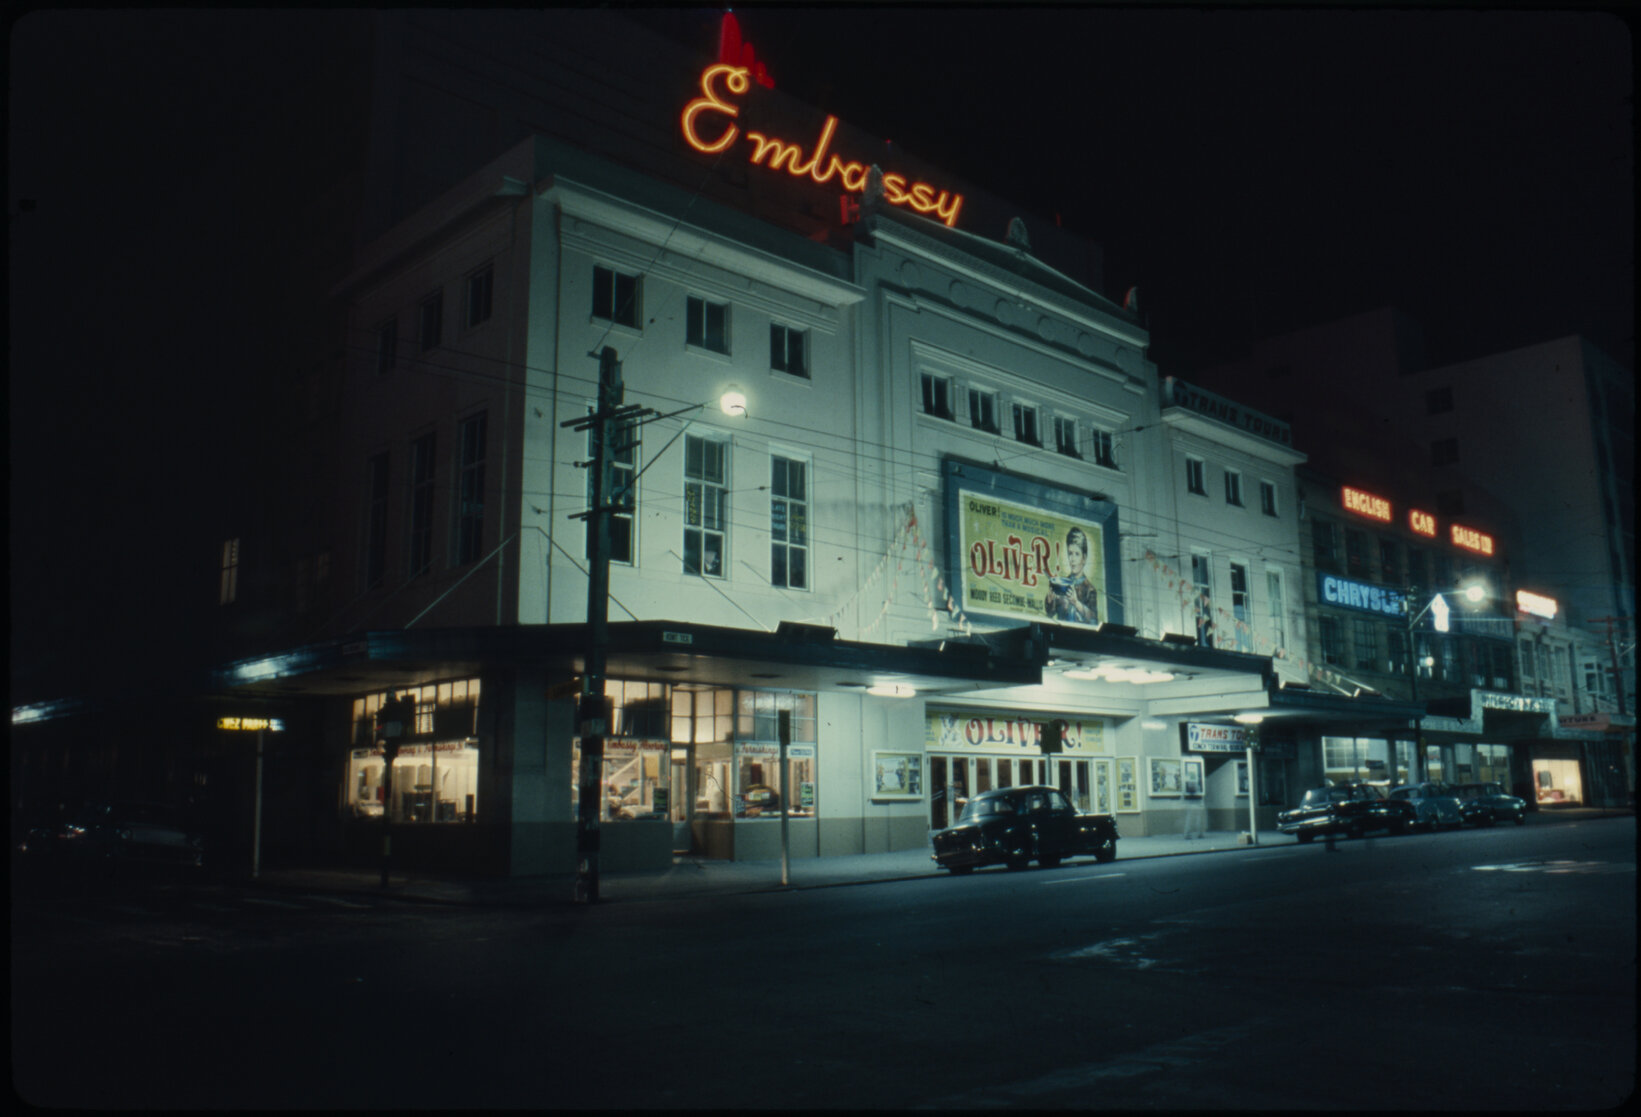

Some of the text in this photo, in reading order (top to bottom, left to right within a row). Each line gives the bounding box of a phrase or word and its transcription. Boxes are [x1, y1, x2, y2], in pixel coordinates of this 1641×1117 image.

[681, 63, 963, 229] Embassy
[969, 501, 1000, 519] OLIVER!
[1342, 487, 1391, 521] ENGLISH
[1410, 510, 1436, 536] CAR
[970, 535, 1060, 587] OLIVER!
[1201, 727, 1229, 740] TRANS
